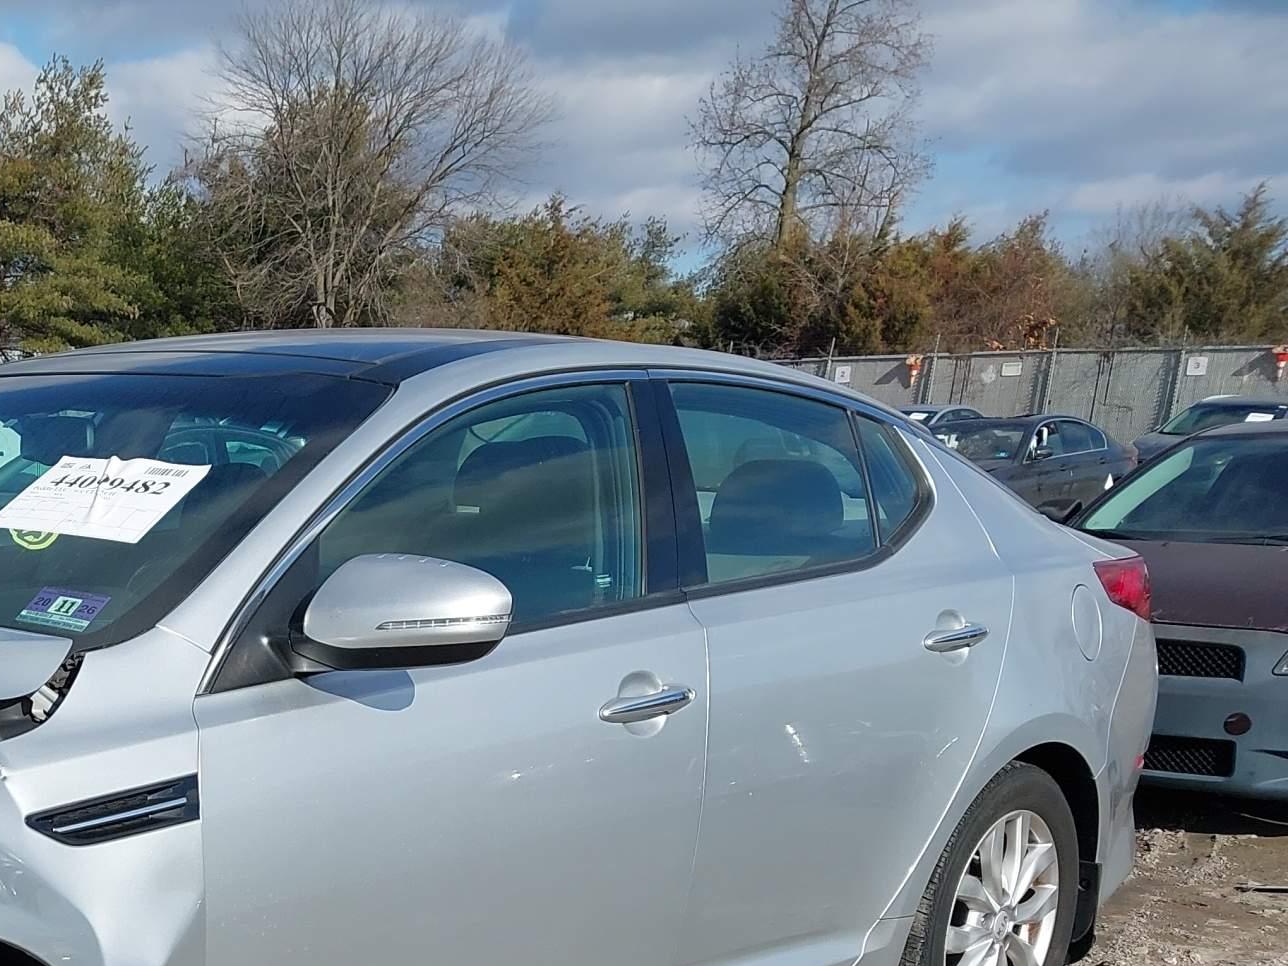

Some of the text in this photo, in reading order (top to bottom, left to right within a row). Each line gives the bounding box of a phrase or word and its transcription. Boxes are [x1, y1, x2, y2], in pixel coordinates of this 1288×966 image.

[33, 596, 98, 615] 20 11 26
